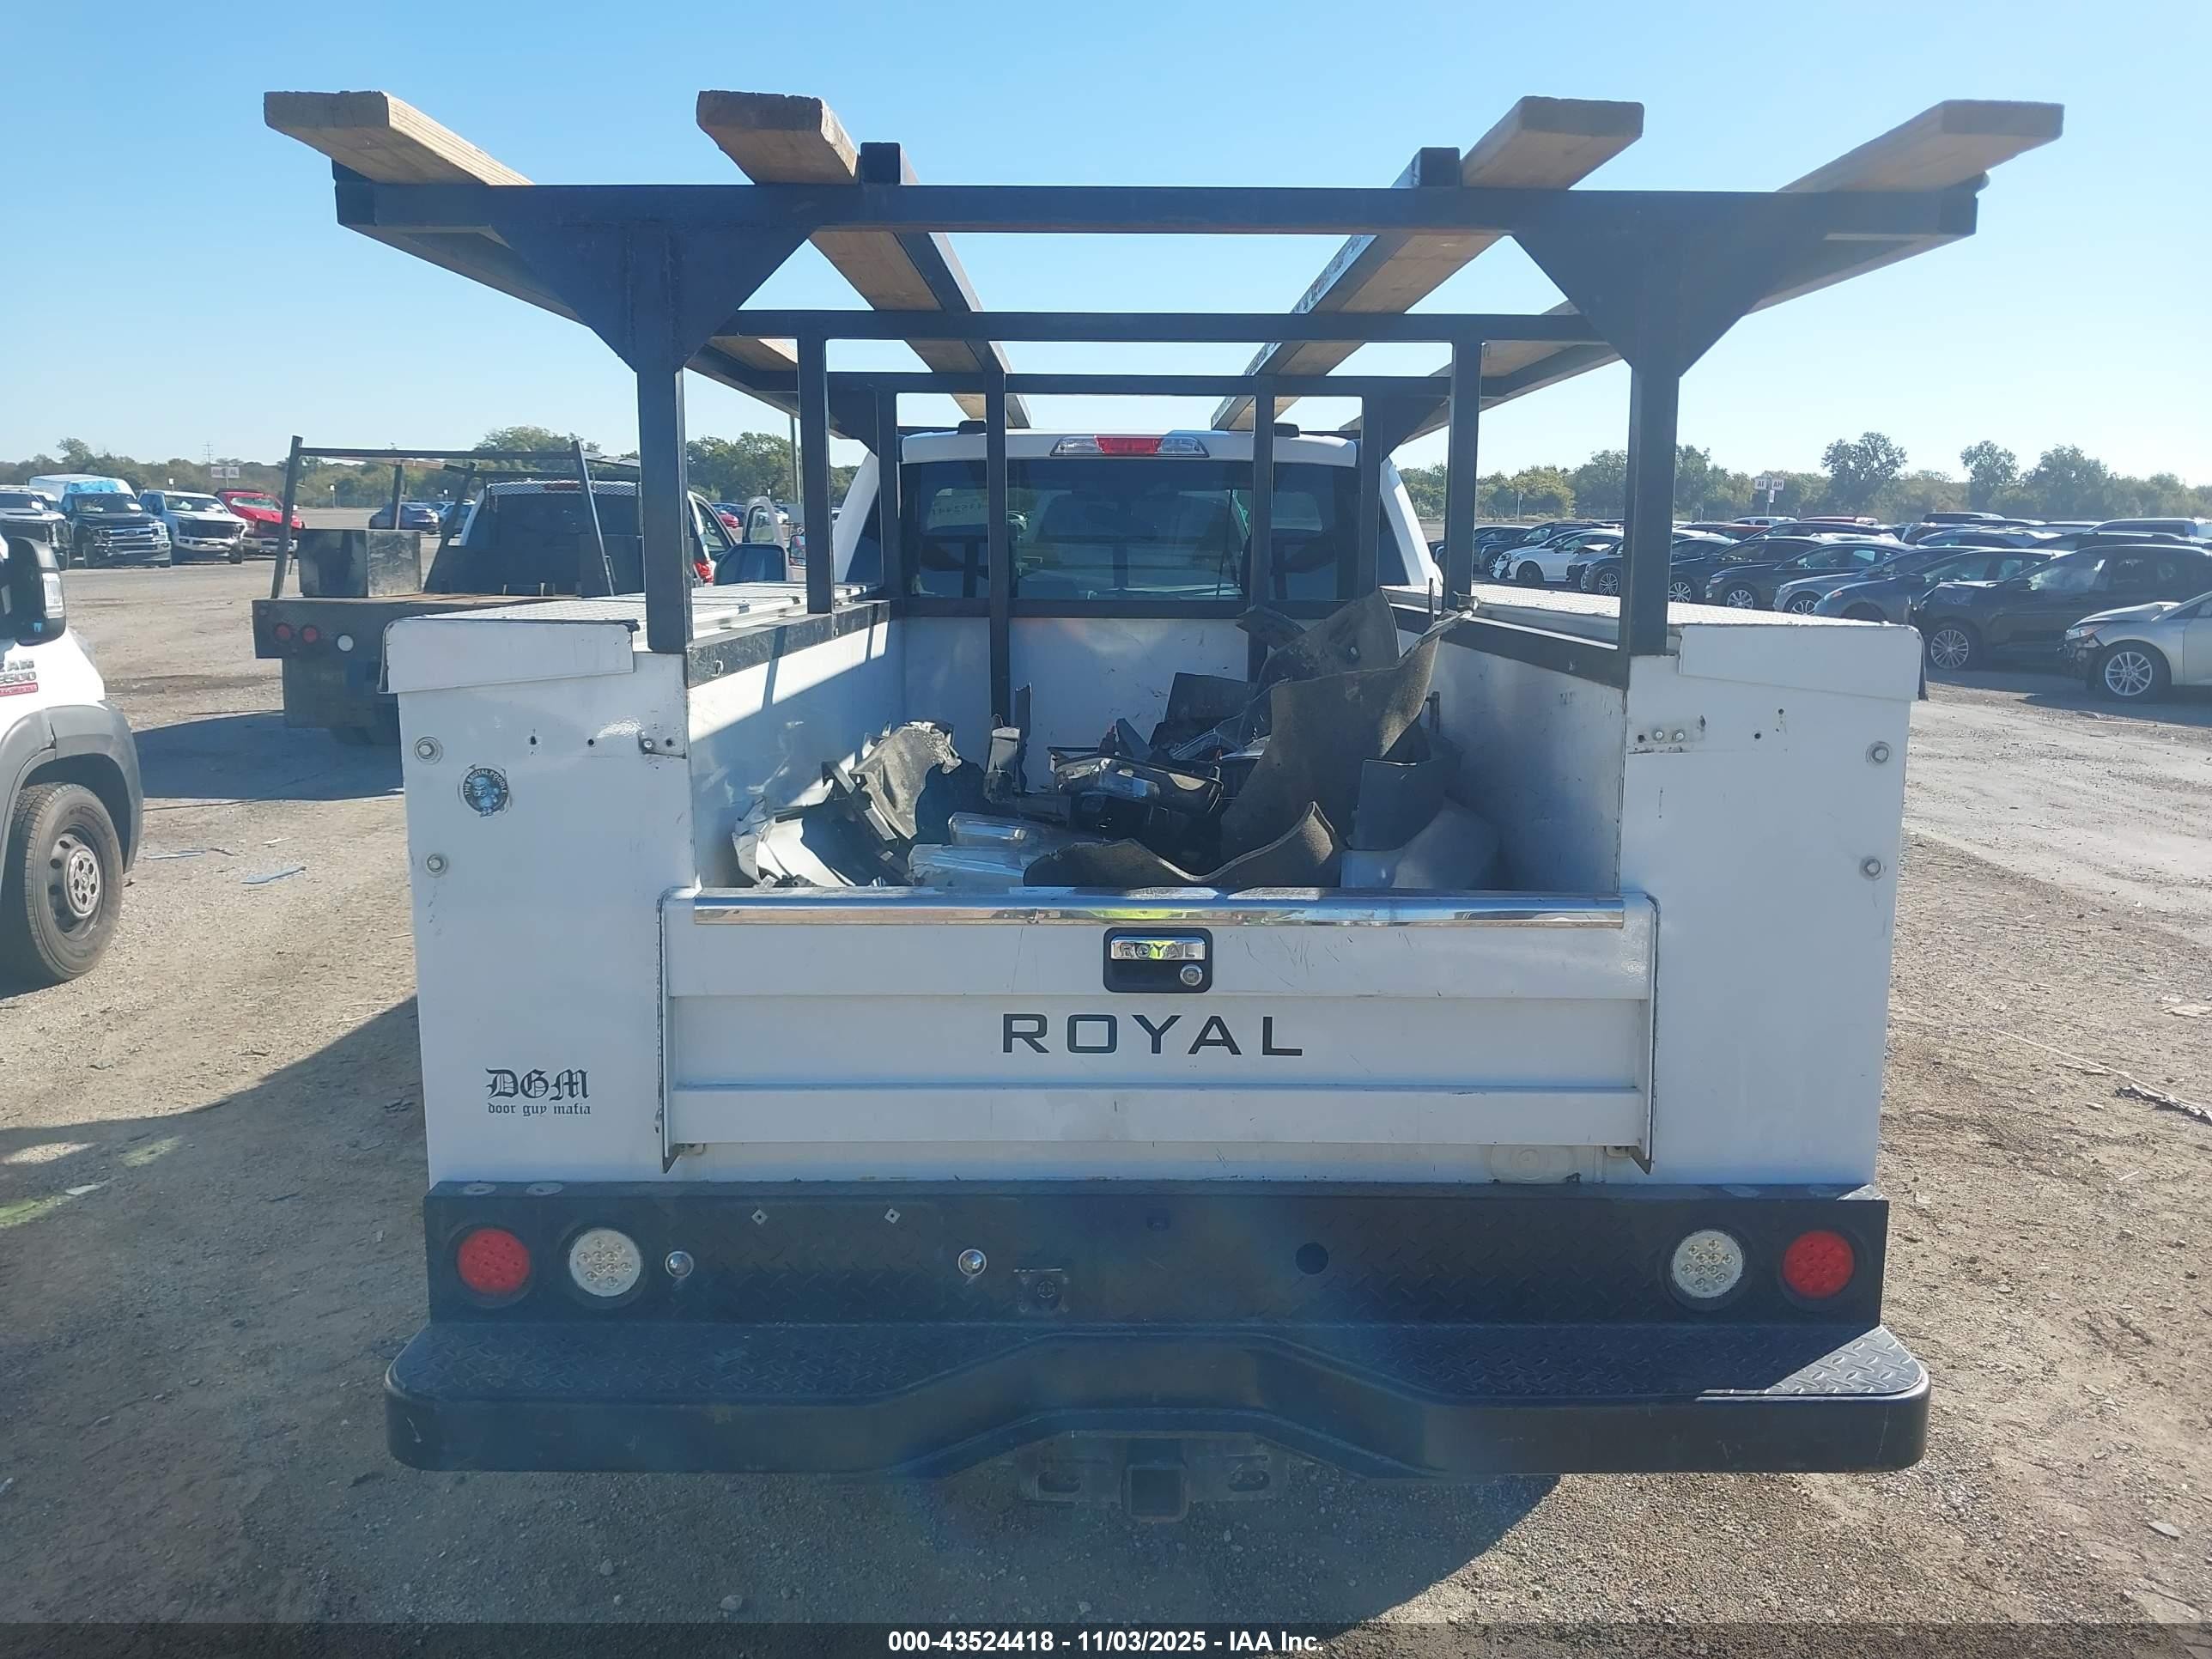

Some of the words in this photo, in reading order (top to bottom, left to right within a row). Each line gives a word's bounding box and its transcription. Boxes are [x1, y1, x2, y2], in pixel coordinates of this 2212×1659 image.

[6, 659, 35, 672] AM
[466, 769, 489, 783] BRUTAL
[489, 770, 507, 793] POODLE
[1120, 942, 1195, 959] ROYAL
[1003, 1013, 1303, 1057] ROYAL
[485, 1067, 590, 1102] DGM
[487, 1102, 516, 1114] door
[522, 1104, 547, 1117] guy
[553, 1103, 591, 1115] mafia
